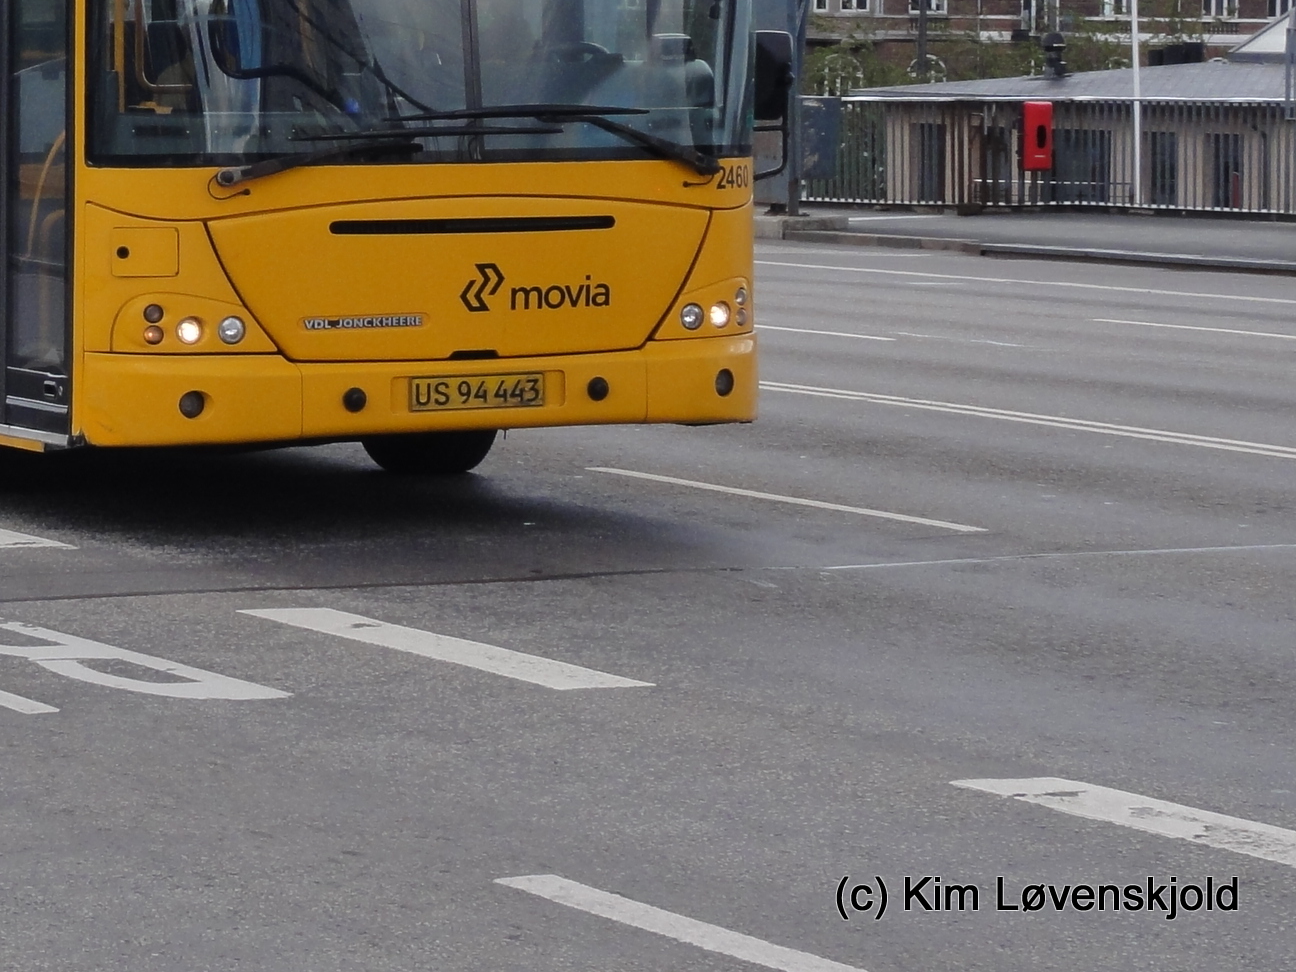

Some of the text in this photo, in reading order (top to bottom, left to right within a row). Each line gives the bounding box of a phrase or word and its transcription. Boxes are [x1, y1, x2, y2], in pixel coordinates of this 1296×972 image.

[716, 164, 749, 190] 2460
[510, 274, 611, 310] movia
[304, 315, 423, 329] VDL JONCKHEERE
[415, 378, 541, 407] US 94 443
